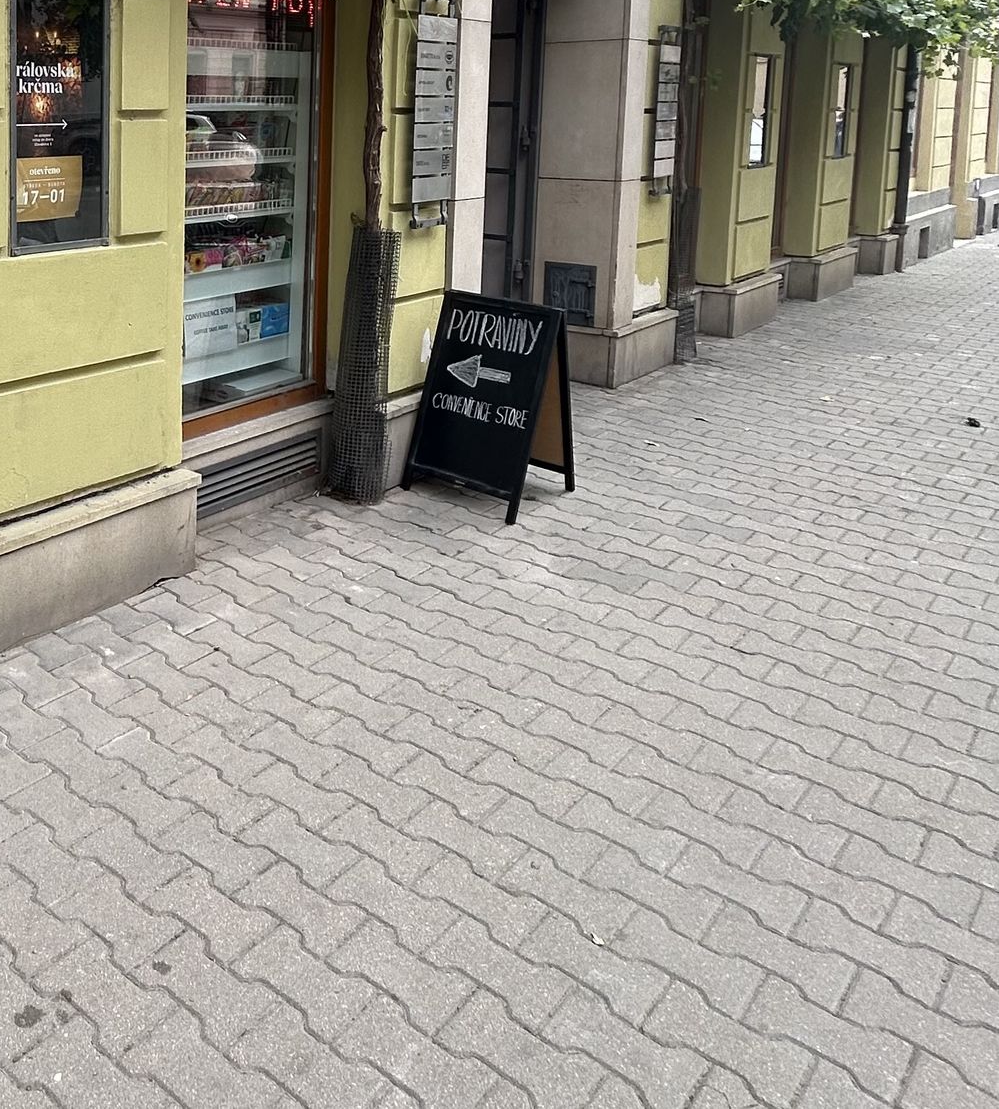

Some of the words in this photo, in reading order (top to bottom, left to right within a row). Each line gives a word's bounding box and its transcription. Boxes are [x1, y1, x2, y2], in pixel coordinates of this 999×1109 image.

[16, 61, 75, 78] rálovská
[18, 78, 63, 94] krčma
[29, 166, 61, 176] otevřeno
[185, 308, 219, 321] CONVENIENCE
[220, 306, 233, 315] STORE
[447, 309, 543, 356] POTRAVINY
[432, 392, 493, 423] CONVENIENCE
[495, 406, 529, 430] STORE
